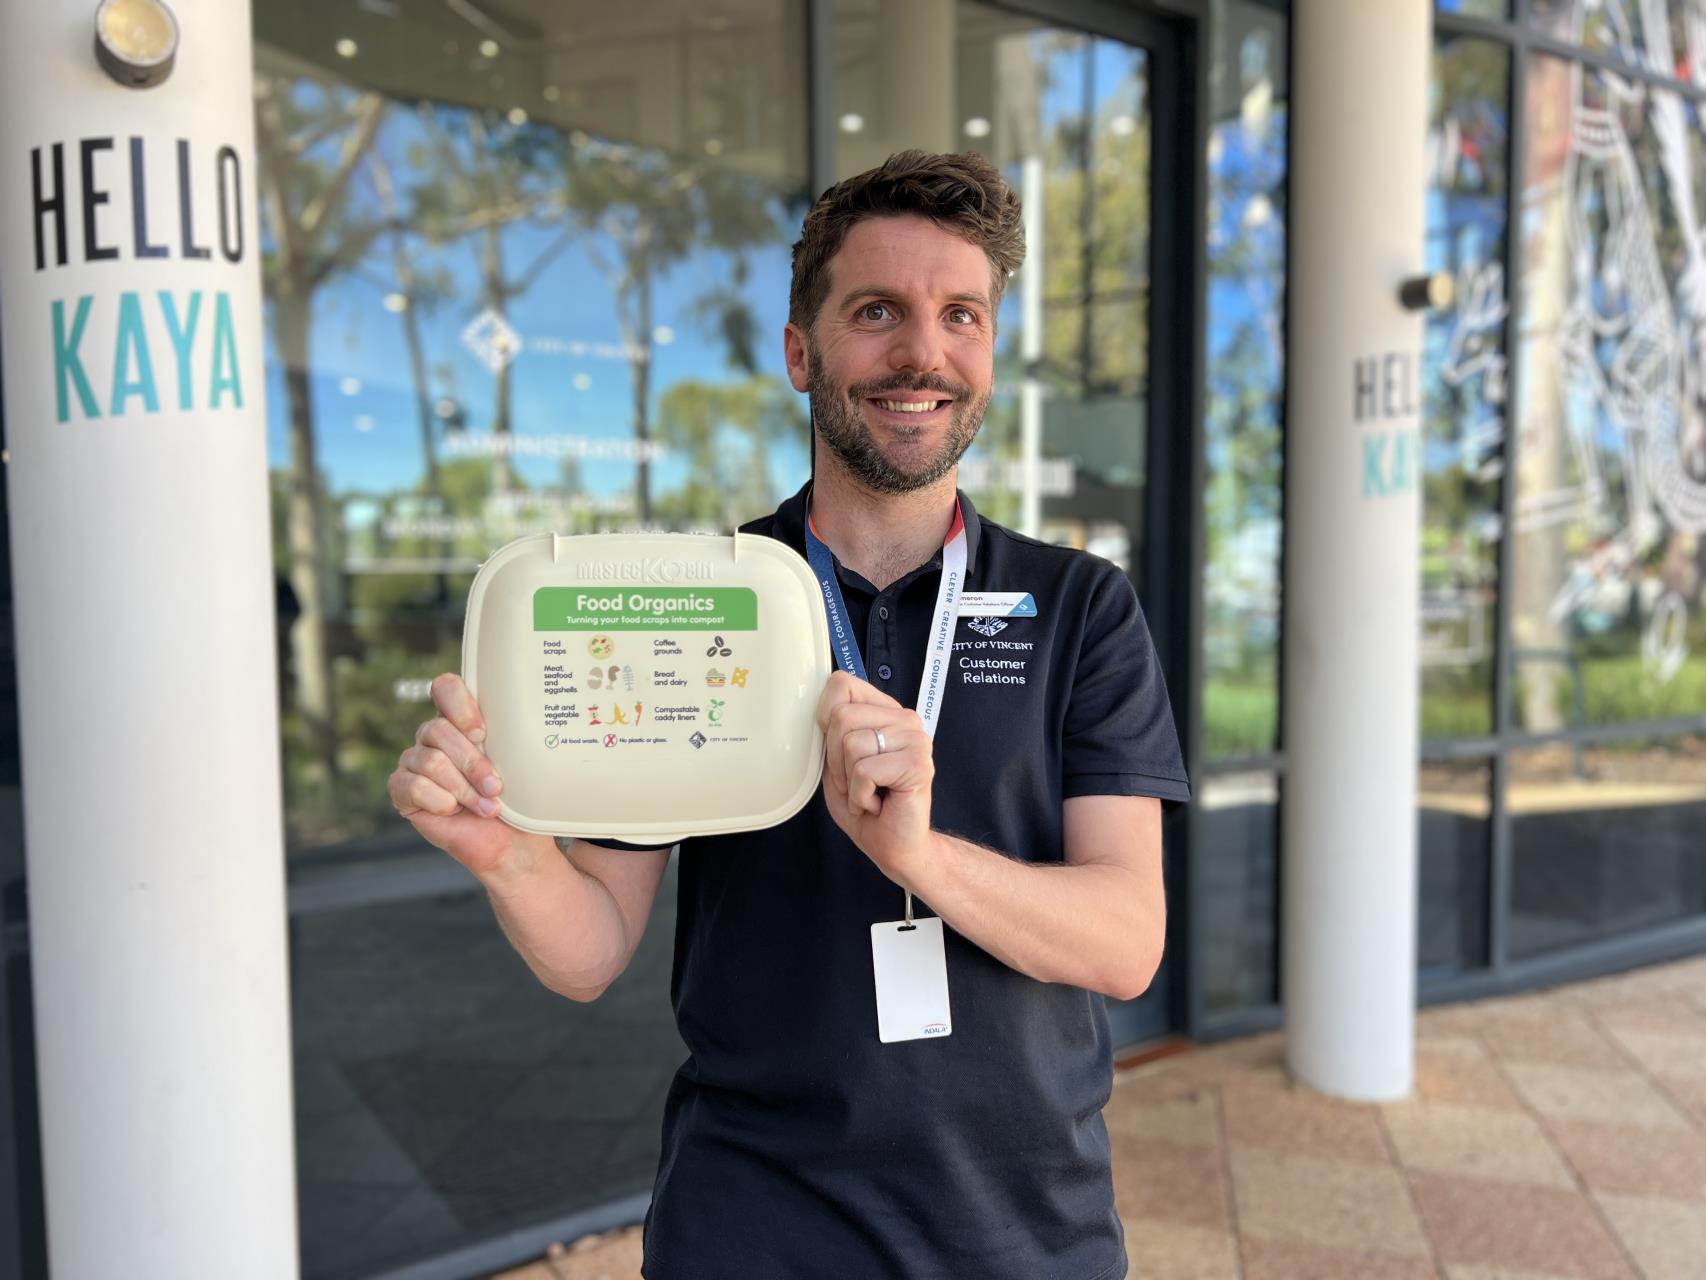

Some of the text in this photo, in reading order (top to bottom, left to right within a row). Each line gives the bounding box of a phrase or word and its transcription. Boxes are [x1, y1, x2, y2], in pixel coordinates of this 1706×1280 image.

[30, 136, 244, 272] HELLO
[51, 290, 244, 424] KAYA
[576, 593, 715, 615] Food Organics
[567, 616, 724, 625] Turning your food scraps into compost
[822, 580, 857, 677] EATIVE COURAGEOUS
[924, 572, 957, 720] CLEVER CREATIVE COURAGEOUS
[951, 641, 1034, 650] CITY OF VINCENT
[653, 648, 682, 656] grounds
[959, 657, 1026, 669] Customer
[669, 679, 687, 687] dairy
[963, 672, 1026, 684] Relations
[544, 686, 578, 695] eggshells
[654, 706, 700, 715] Compostable
[654, 714, 676, 722] caddy
